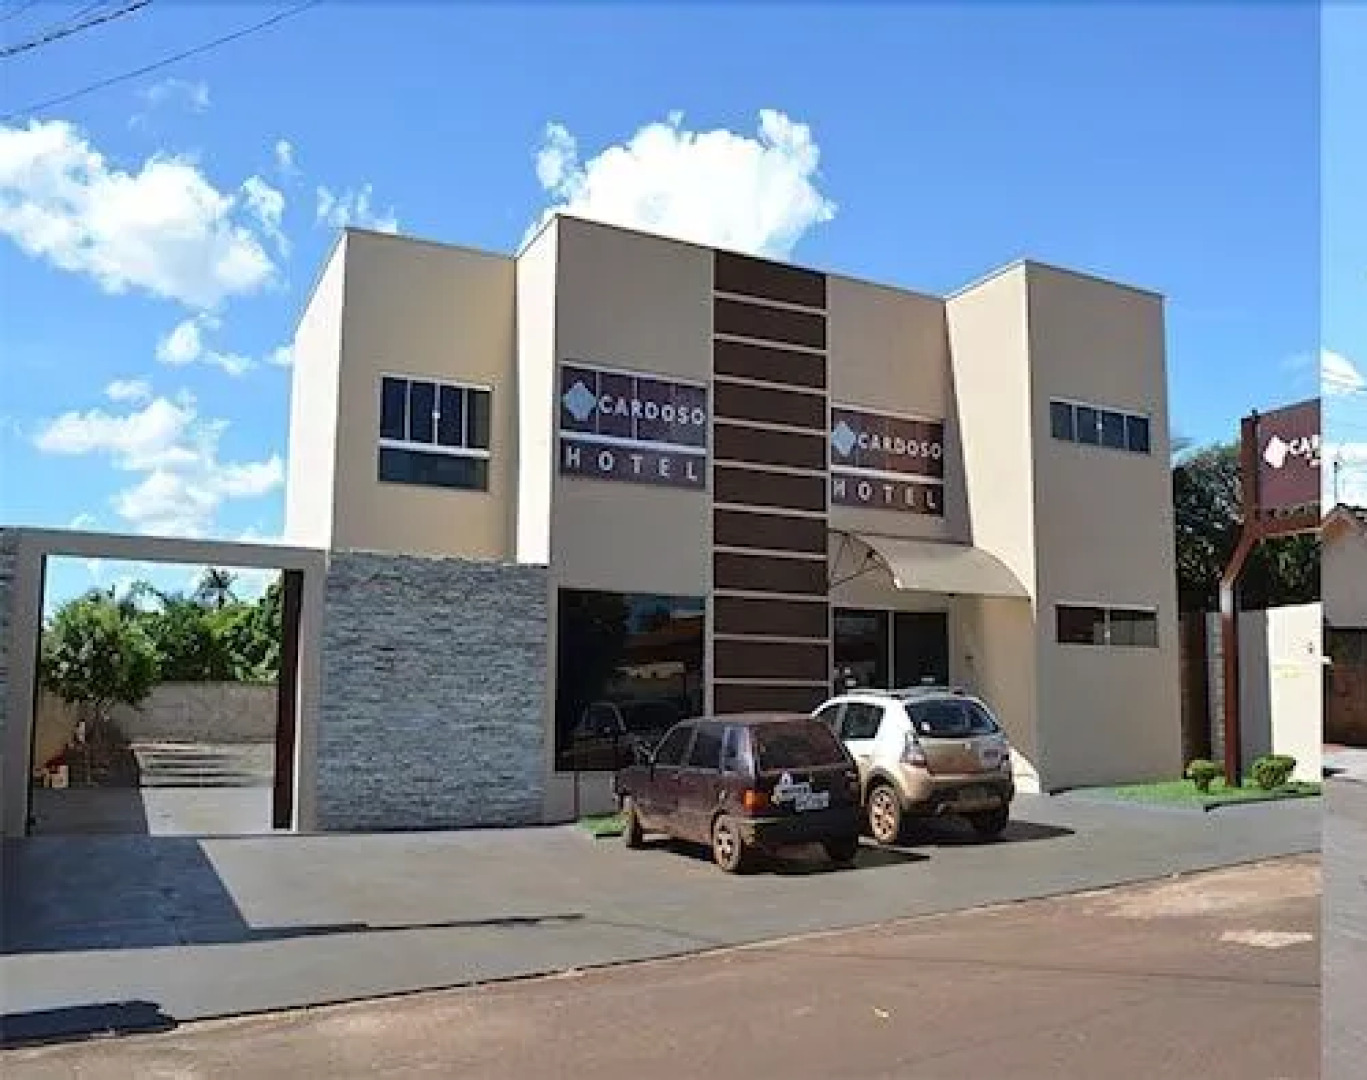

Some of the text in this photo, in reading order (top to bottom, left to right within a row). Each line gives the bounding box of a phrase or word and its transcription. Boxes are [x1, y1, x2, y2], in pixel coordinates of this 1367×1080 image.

[599, 394, 705, 425] CARDOSO
[858, 431, 941, 459] CARDOSO
[565, 445, 698, 482] HOTEL
[832, 480, 936, 509] HOTEL
